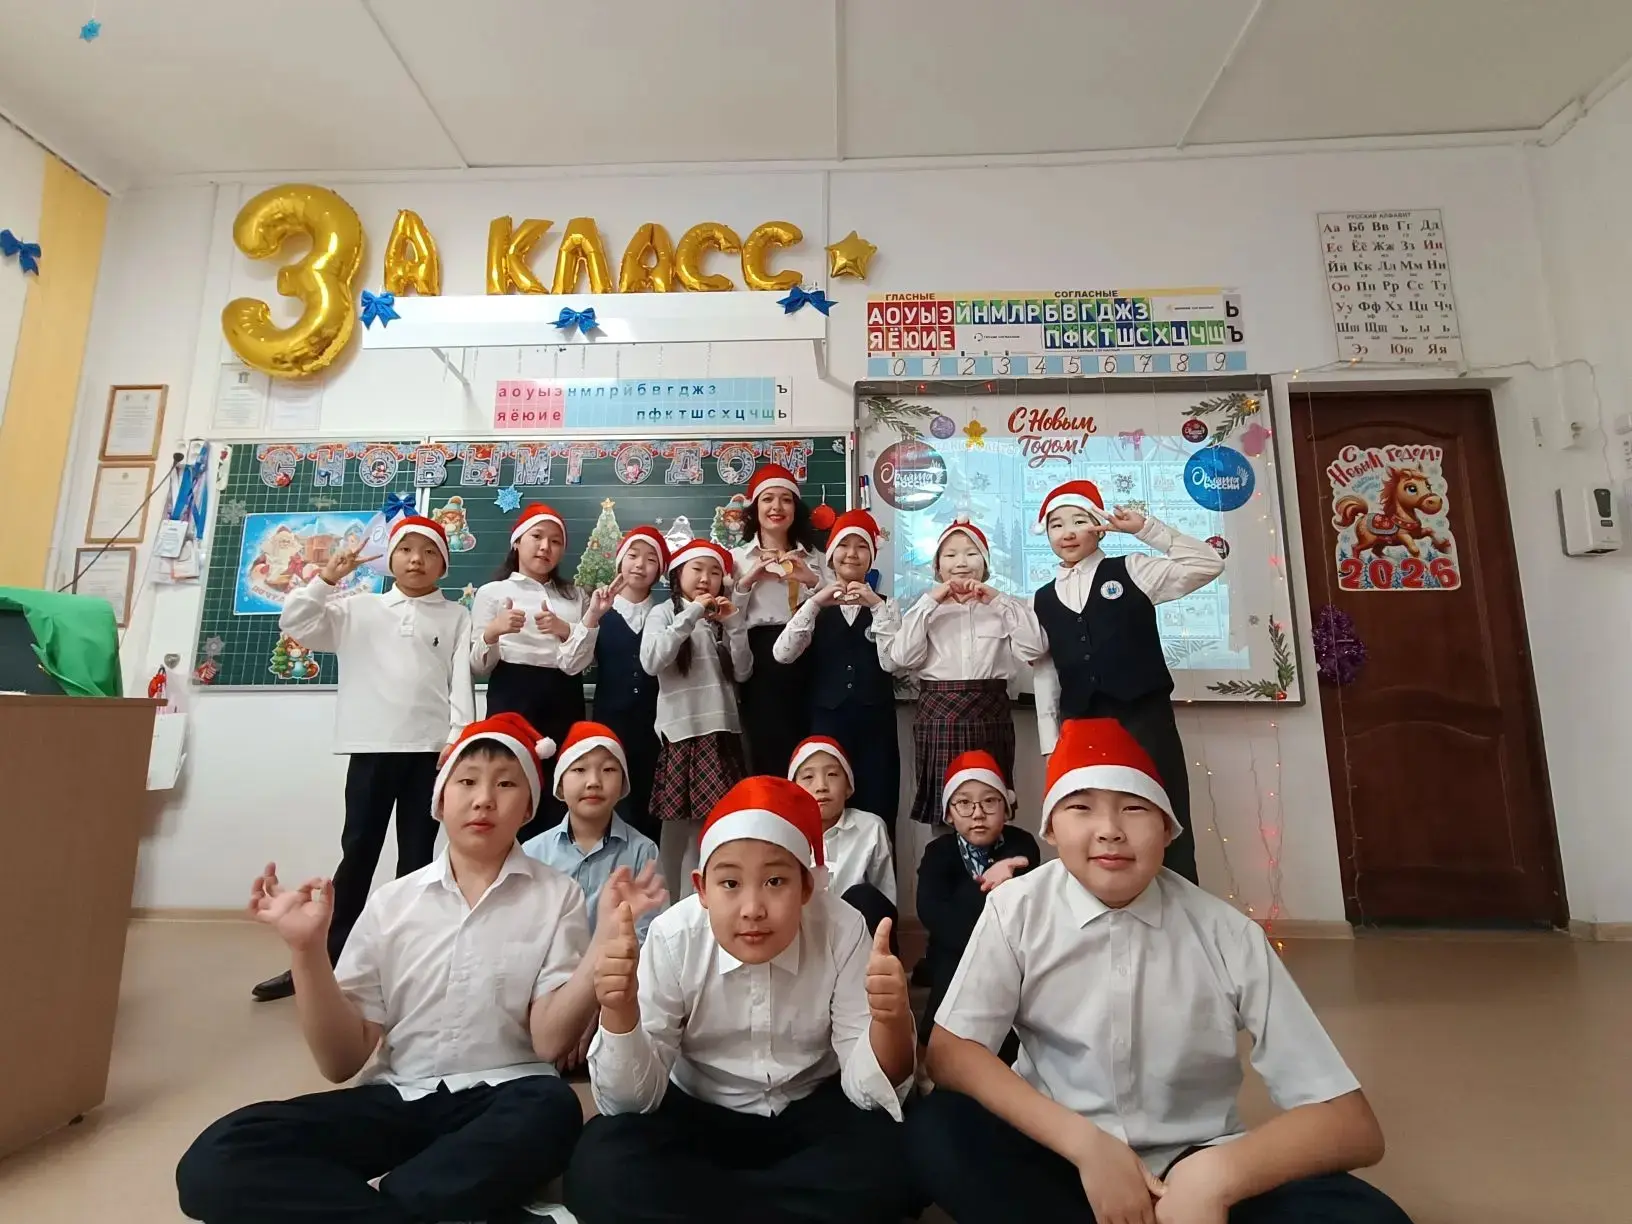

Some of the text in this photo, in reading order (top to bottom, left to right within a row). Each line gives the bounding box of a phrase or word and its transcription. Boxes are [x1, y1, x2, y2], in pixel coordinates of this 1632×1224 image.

[1324, 220, 1440, 233] Аа Бб Вв Гг Дд
[1326, 239, 1443, 253] Ее Ёё Жж Зз Ии
[1328, 259, 1446, 273] Йй Кк Лл Мм Нн
[222, 183, 804, 378] 3 А КЛАСС
[1331, 280, 1447, 293] Оо Пп Рр Сс Тт
[885, 290, 1118, 301] ГЛАСНЫЕ СОГЛАСНЫЕ
[1336, 301, 1452, 315] Уу Фф Хх Цц Чч
[1352, 343, 1447, 355] Ээ Юю Яя
[893, 352, 1226, 376] 0 1 2 3 4 5 6 7 8 9
[1007, 406, 1098, 434] С Новым
[1017, 432, 1089, 468] Годом!
[1342, 446, 1357, 463] С
[261, 445, 808, 488] С НОВЫМ ГОДОМ
[1339, 557, 1460, 590] 2026
